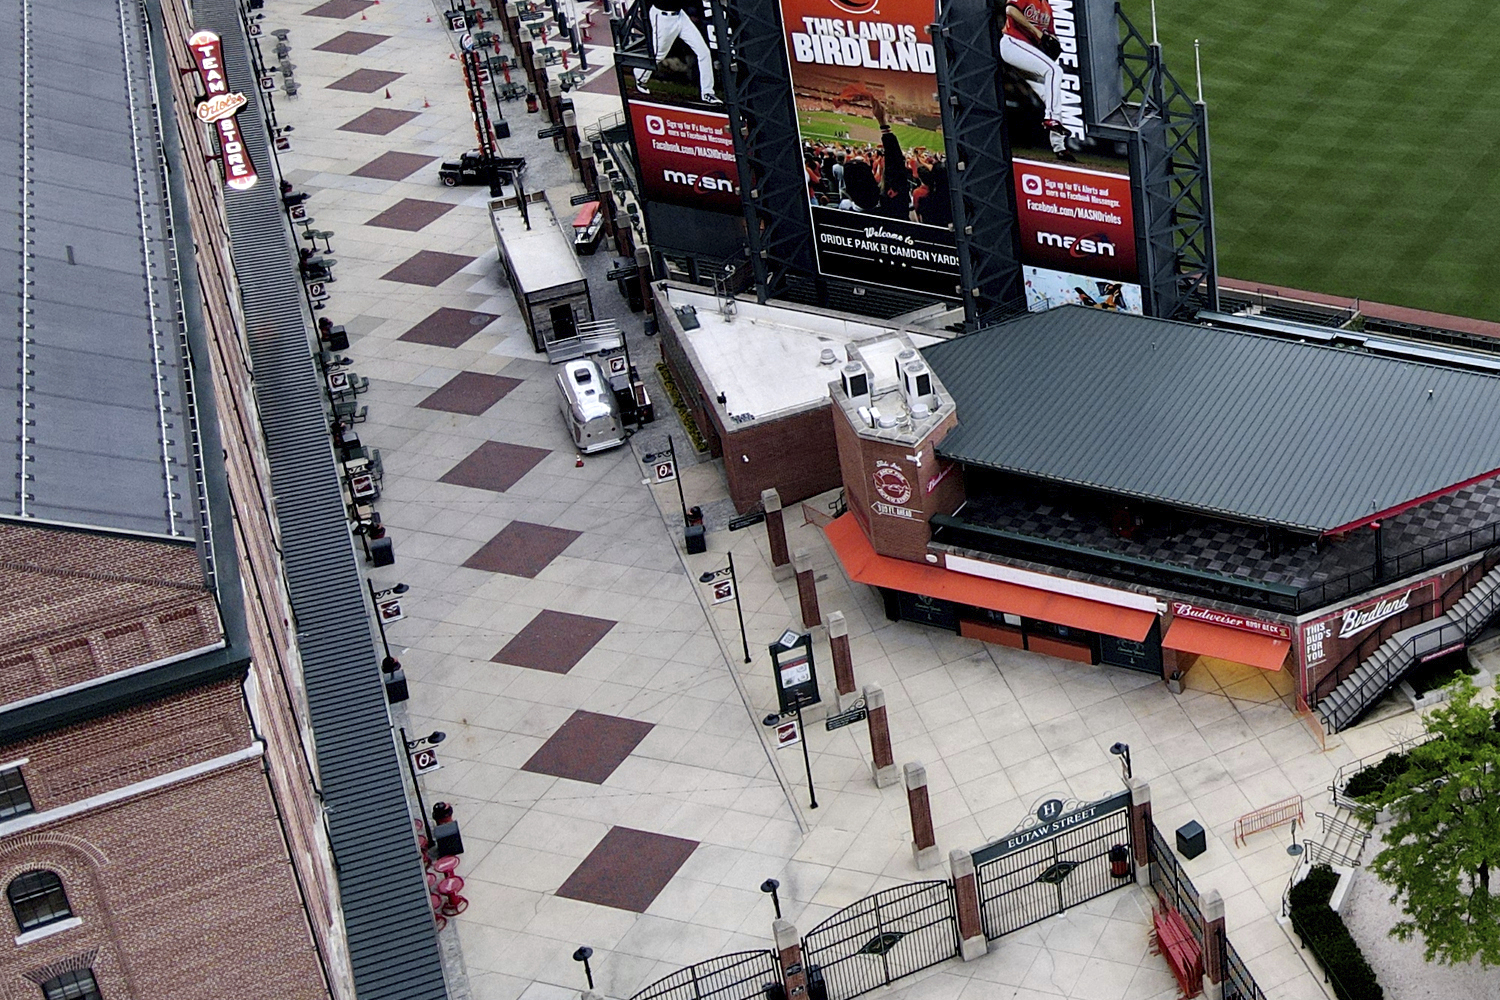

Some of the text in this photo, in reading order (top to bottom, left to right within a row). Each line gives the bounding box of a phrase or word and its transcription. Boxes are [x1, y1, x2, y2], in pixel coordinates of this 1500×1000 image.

[802, 17, 917, 44] THIS LAND IS
[791, 32, 936, 73] BIRDLAND
[198, 45, 224, 93] TEAM
[199, 94, 246, 119] Orioles
[221, 119, 248, 176] STORE
[687, 131, 708, 141] Facebook
[663, 169, 733, 193] masn
[1044, 178, 1056, 189] Sign
[1057, 182, 1064, 191] up
[1064, 181, 1072, 190] for
[1082, 184, 1098, 195] Alerts
[1099, 188, 1109, 196] and
[1067, 191, 1090, 203] Facebook
[1027, 199, 1122, 225] Facebook.com/MASNOrioles
[820, 233, 853, 248] ORIOLE
[854, 239, 880, 252] PARK
[890, 245, 929, 261] CAMDEN
[864, 226, 914, 245] Welcome to
[1037, 231, 1115, 256] masn
[1173, 602, 1243, 626] Budweiser
[1338, 589, 1412, 638] Birdland
[1306, 622, 1325, 636] THIS
[1306, 629, 1331, 645] BUD'S
[1306, 641, 1322, 654] FOR
[1306, 650, 1325, 662] YOU.
[1043, 802, 1055, 816] H
[1007, 807, 1097, 848] EUTAW STREET
